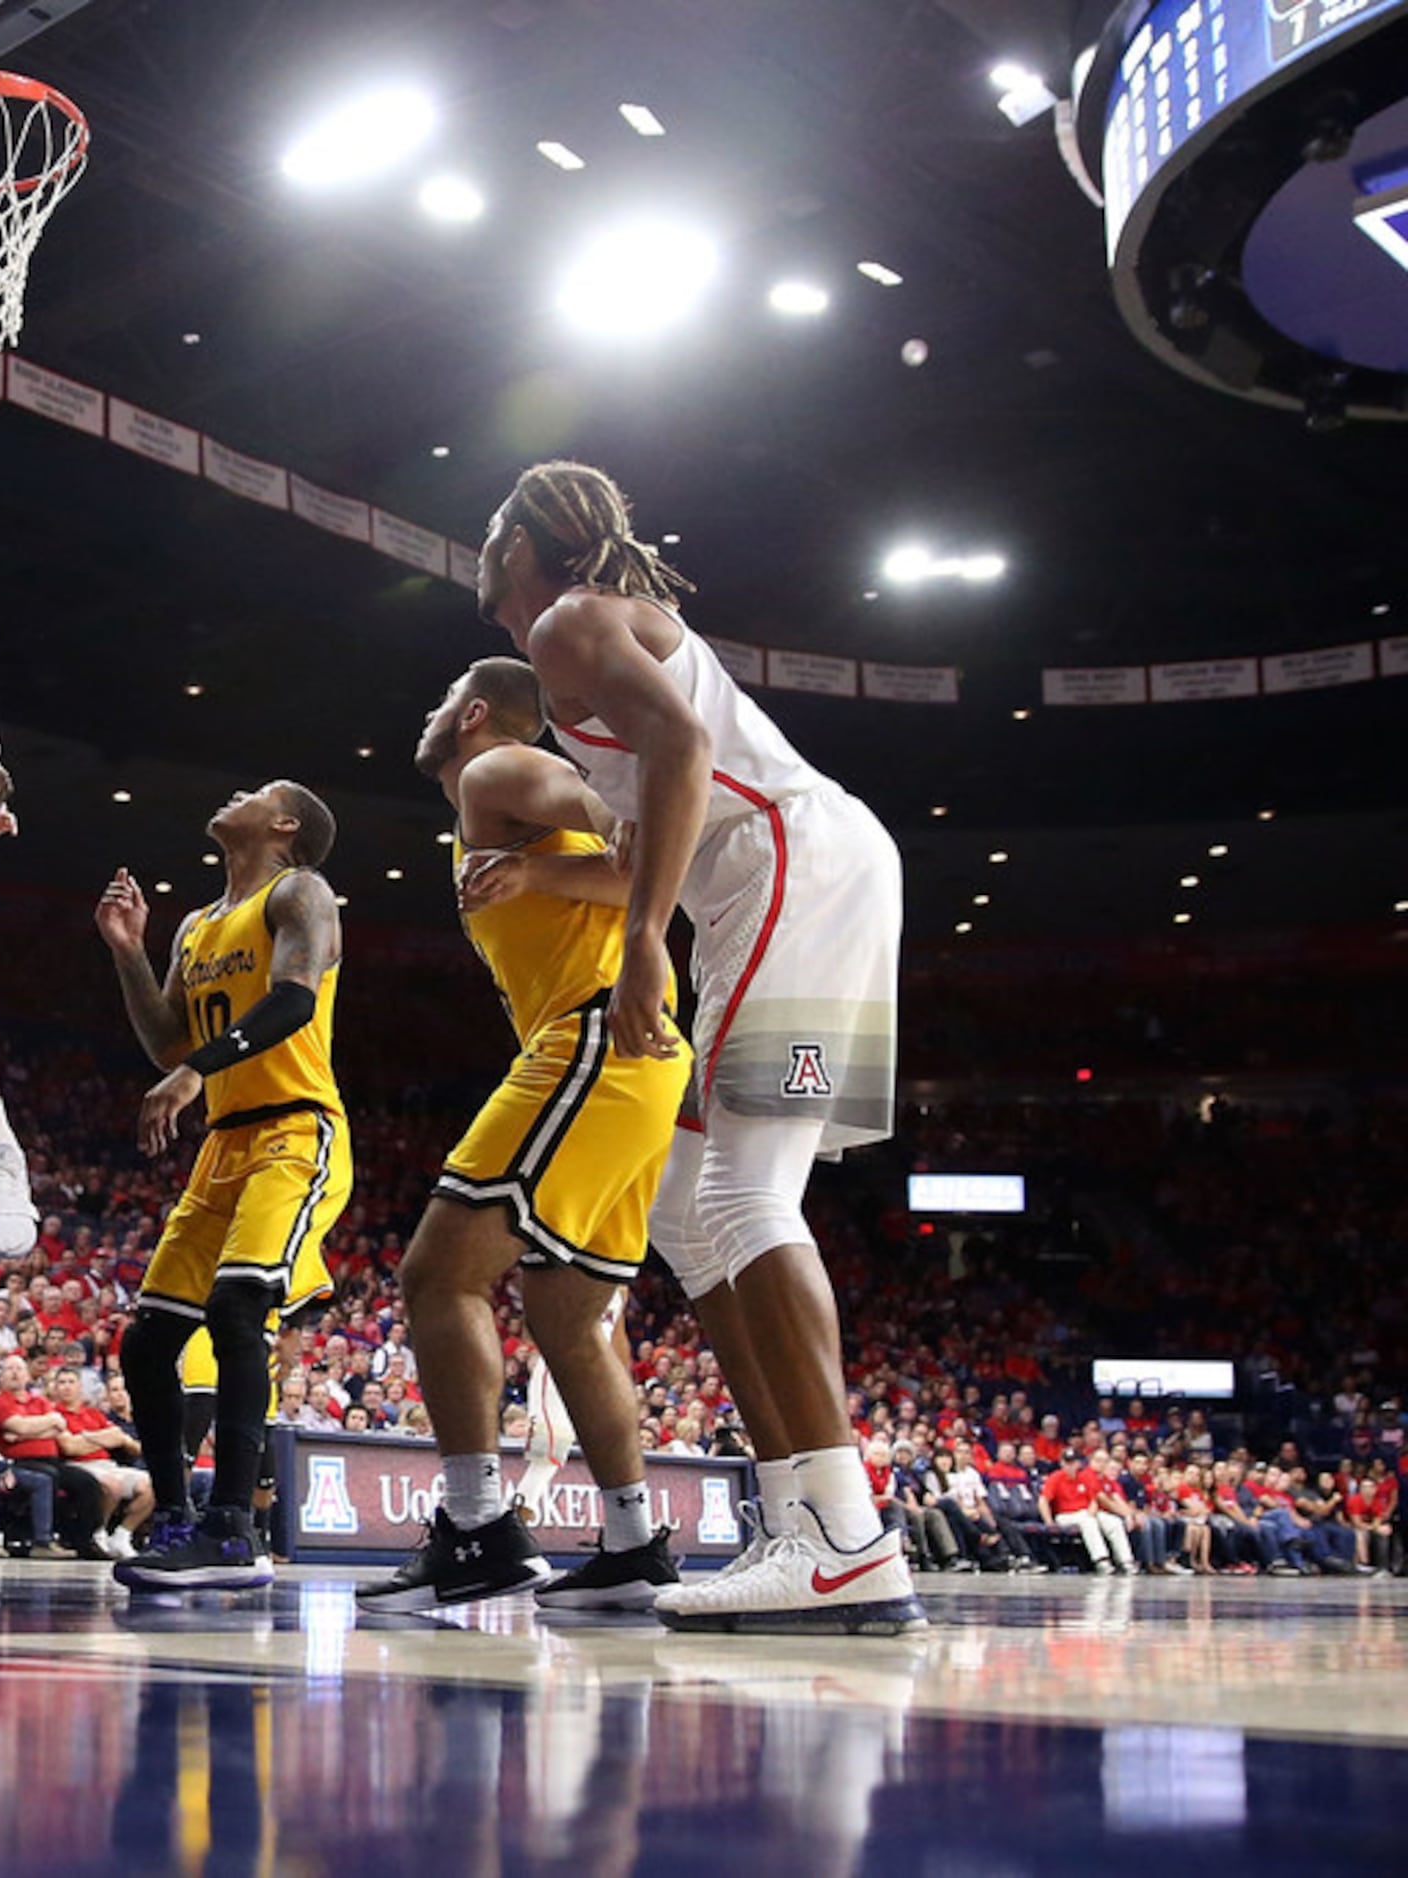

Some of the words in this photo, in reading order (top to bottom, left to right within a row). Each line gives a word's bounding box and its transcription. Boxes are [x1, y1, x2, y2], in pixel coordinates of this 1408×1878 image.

[781, 1043, 833, 1097] A
[300, 1455, 359, 1534] A
[379, 1472, 447, 1527] Uof
[501, 1479, 682, 1532] SKETLL
[698, 1477, 741, 1544] A
